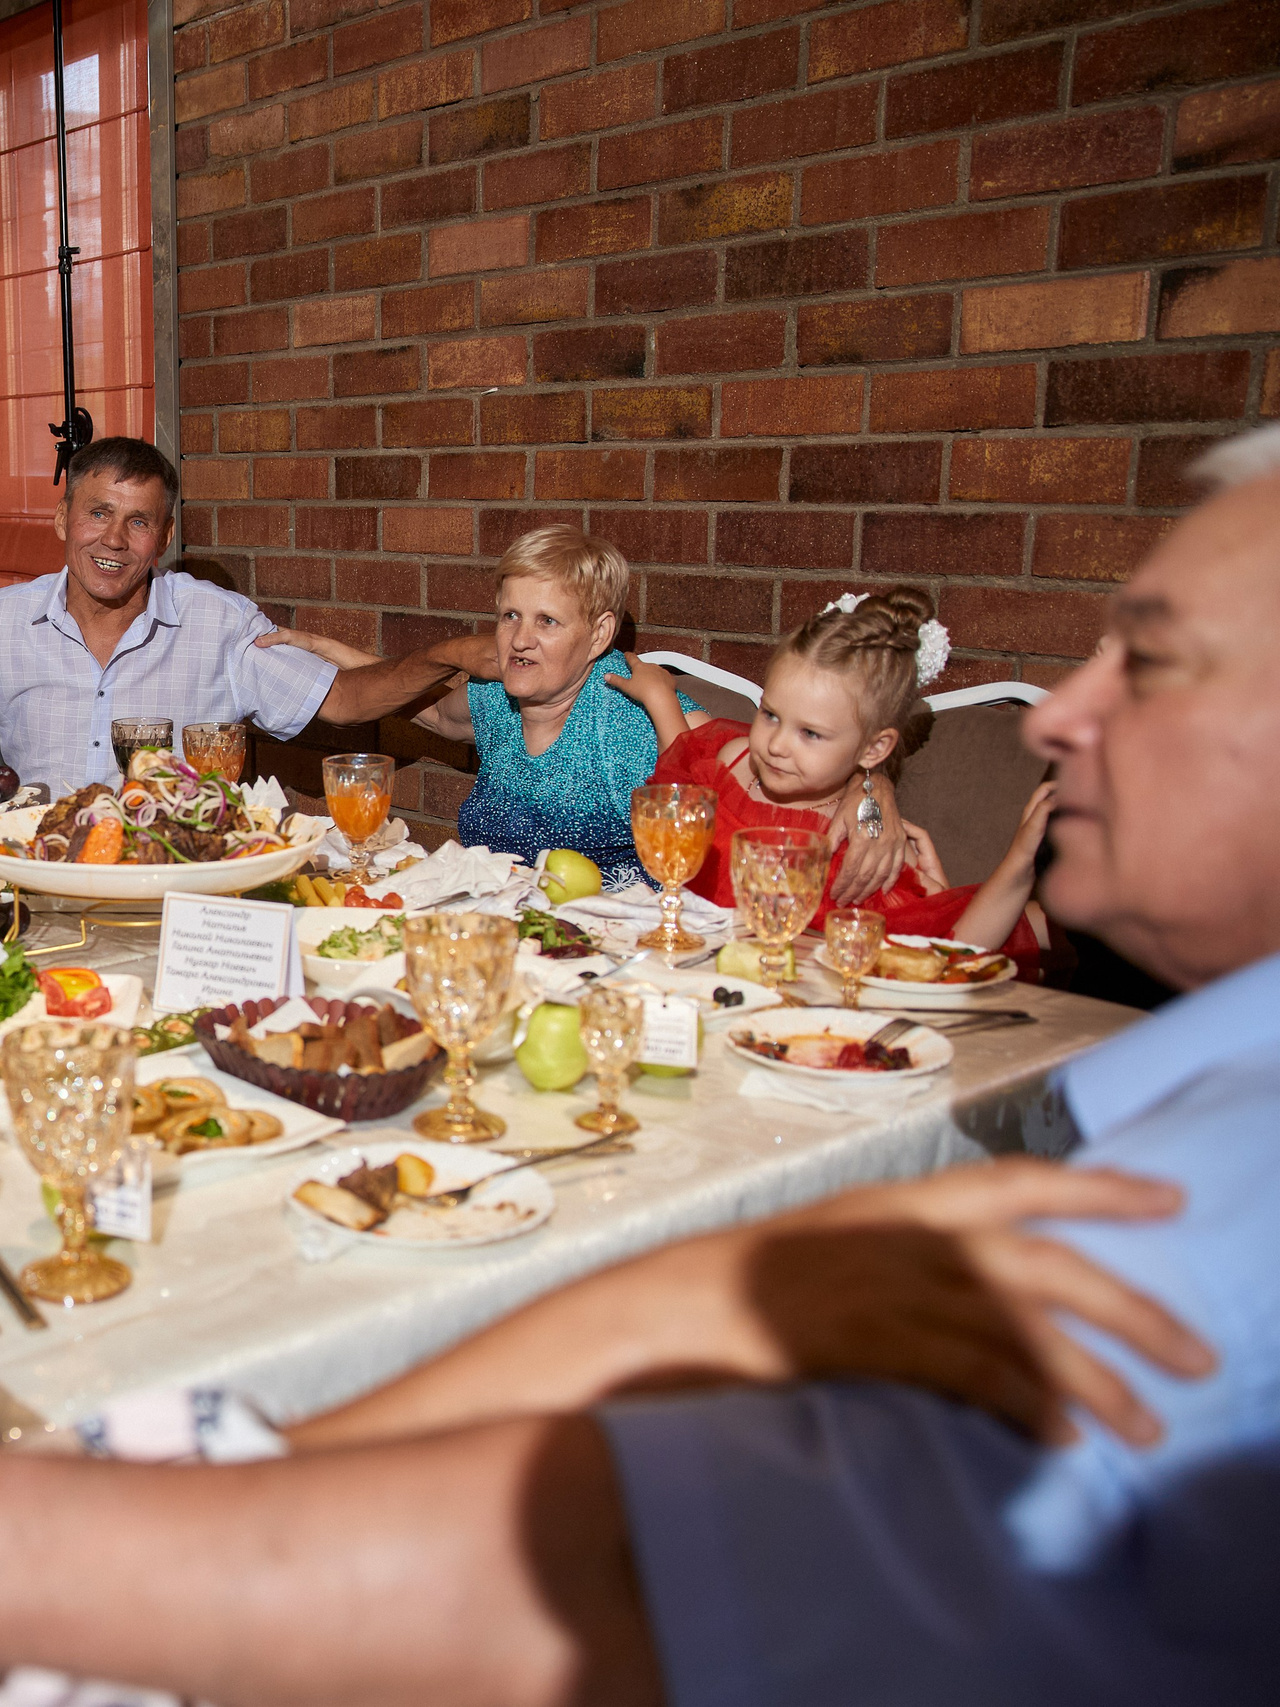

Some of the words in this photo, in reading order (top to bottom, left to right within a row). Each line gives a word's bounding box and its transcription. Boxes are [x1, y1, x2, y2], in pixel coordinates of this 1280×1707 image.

[200, 906, 251, 920] Александр
[202, 920, 247, 931] Наталья
[172, 928, 213, 941] Николай
[215, 934, 274, 948] Николаевич
[172, 940, 204, 952] Галина
[207, 947, 273, 962] Анатольевна
[166, 966, 198, 978] Тамара
[202, 972, 275, 988] Александровна
[201, 984, 234, 996] Ирина
